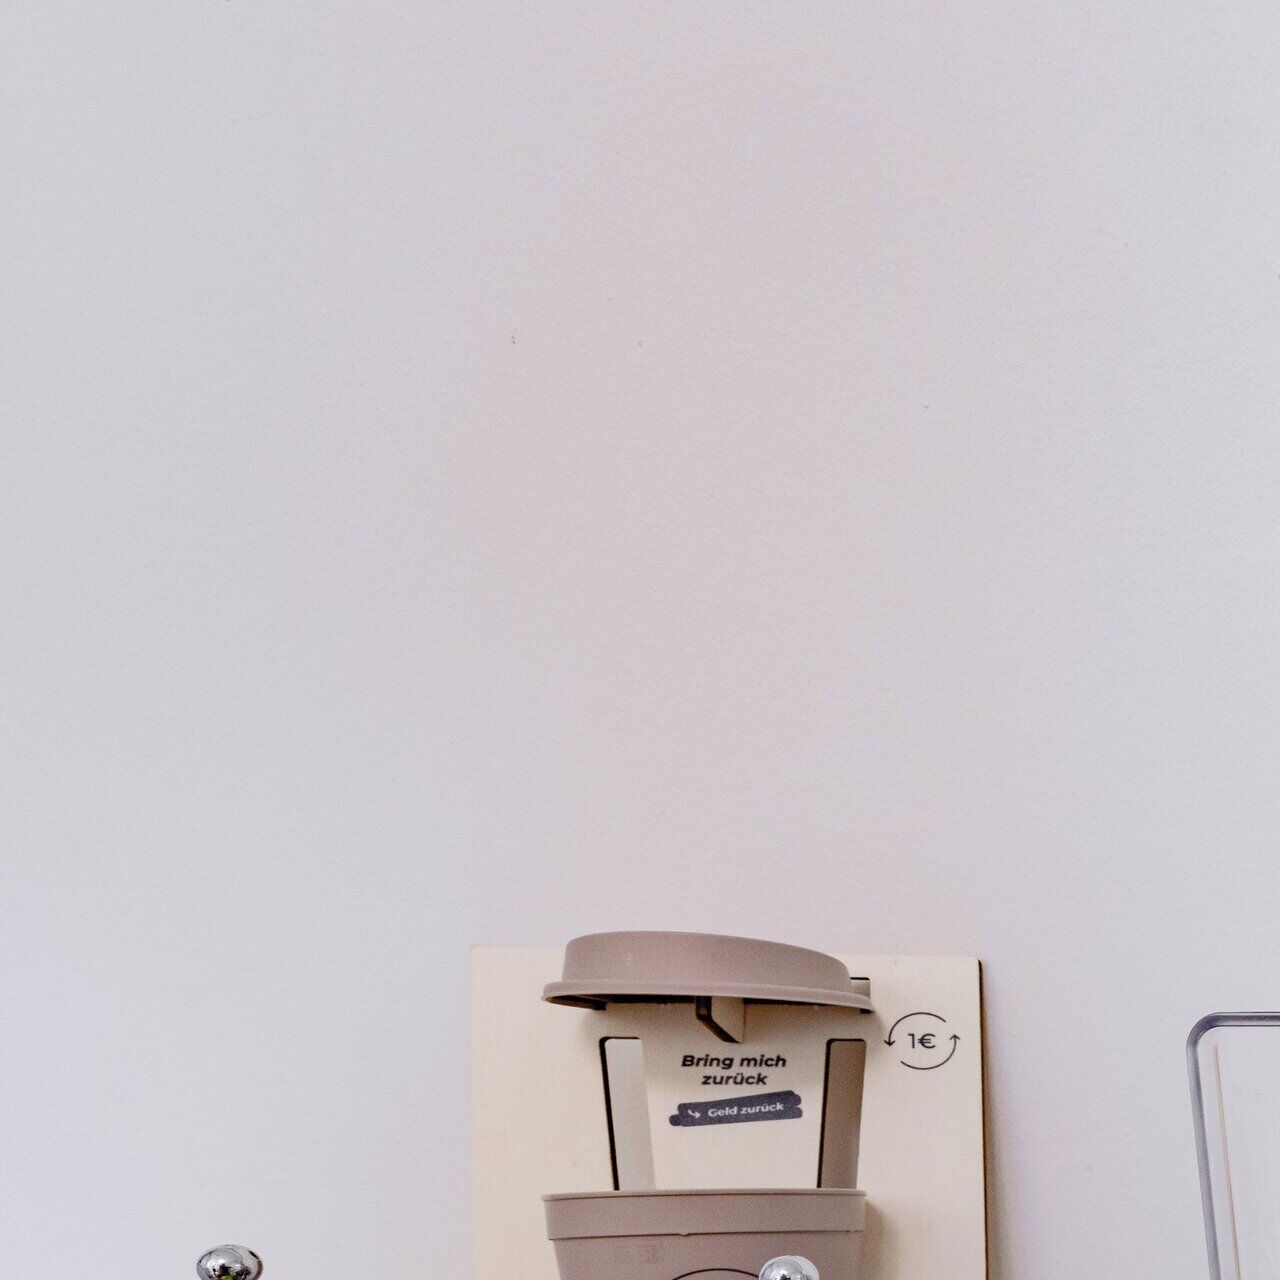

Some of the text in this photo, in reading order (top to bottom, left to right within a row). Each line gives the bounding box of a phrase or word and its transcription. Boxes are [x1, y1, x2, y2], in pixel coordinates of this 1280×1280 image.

[907, 1033, 936, 1049] 1€
[681, 1054, 787, 1070] Bring mich
[701, 1073, 768, 1085] zurück
[708, 1102, 784, 1117] Geld zurück
